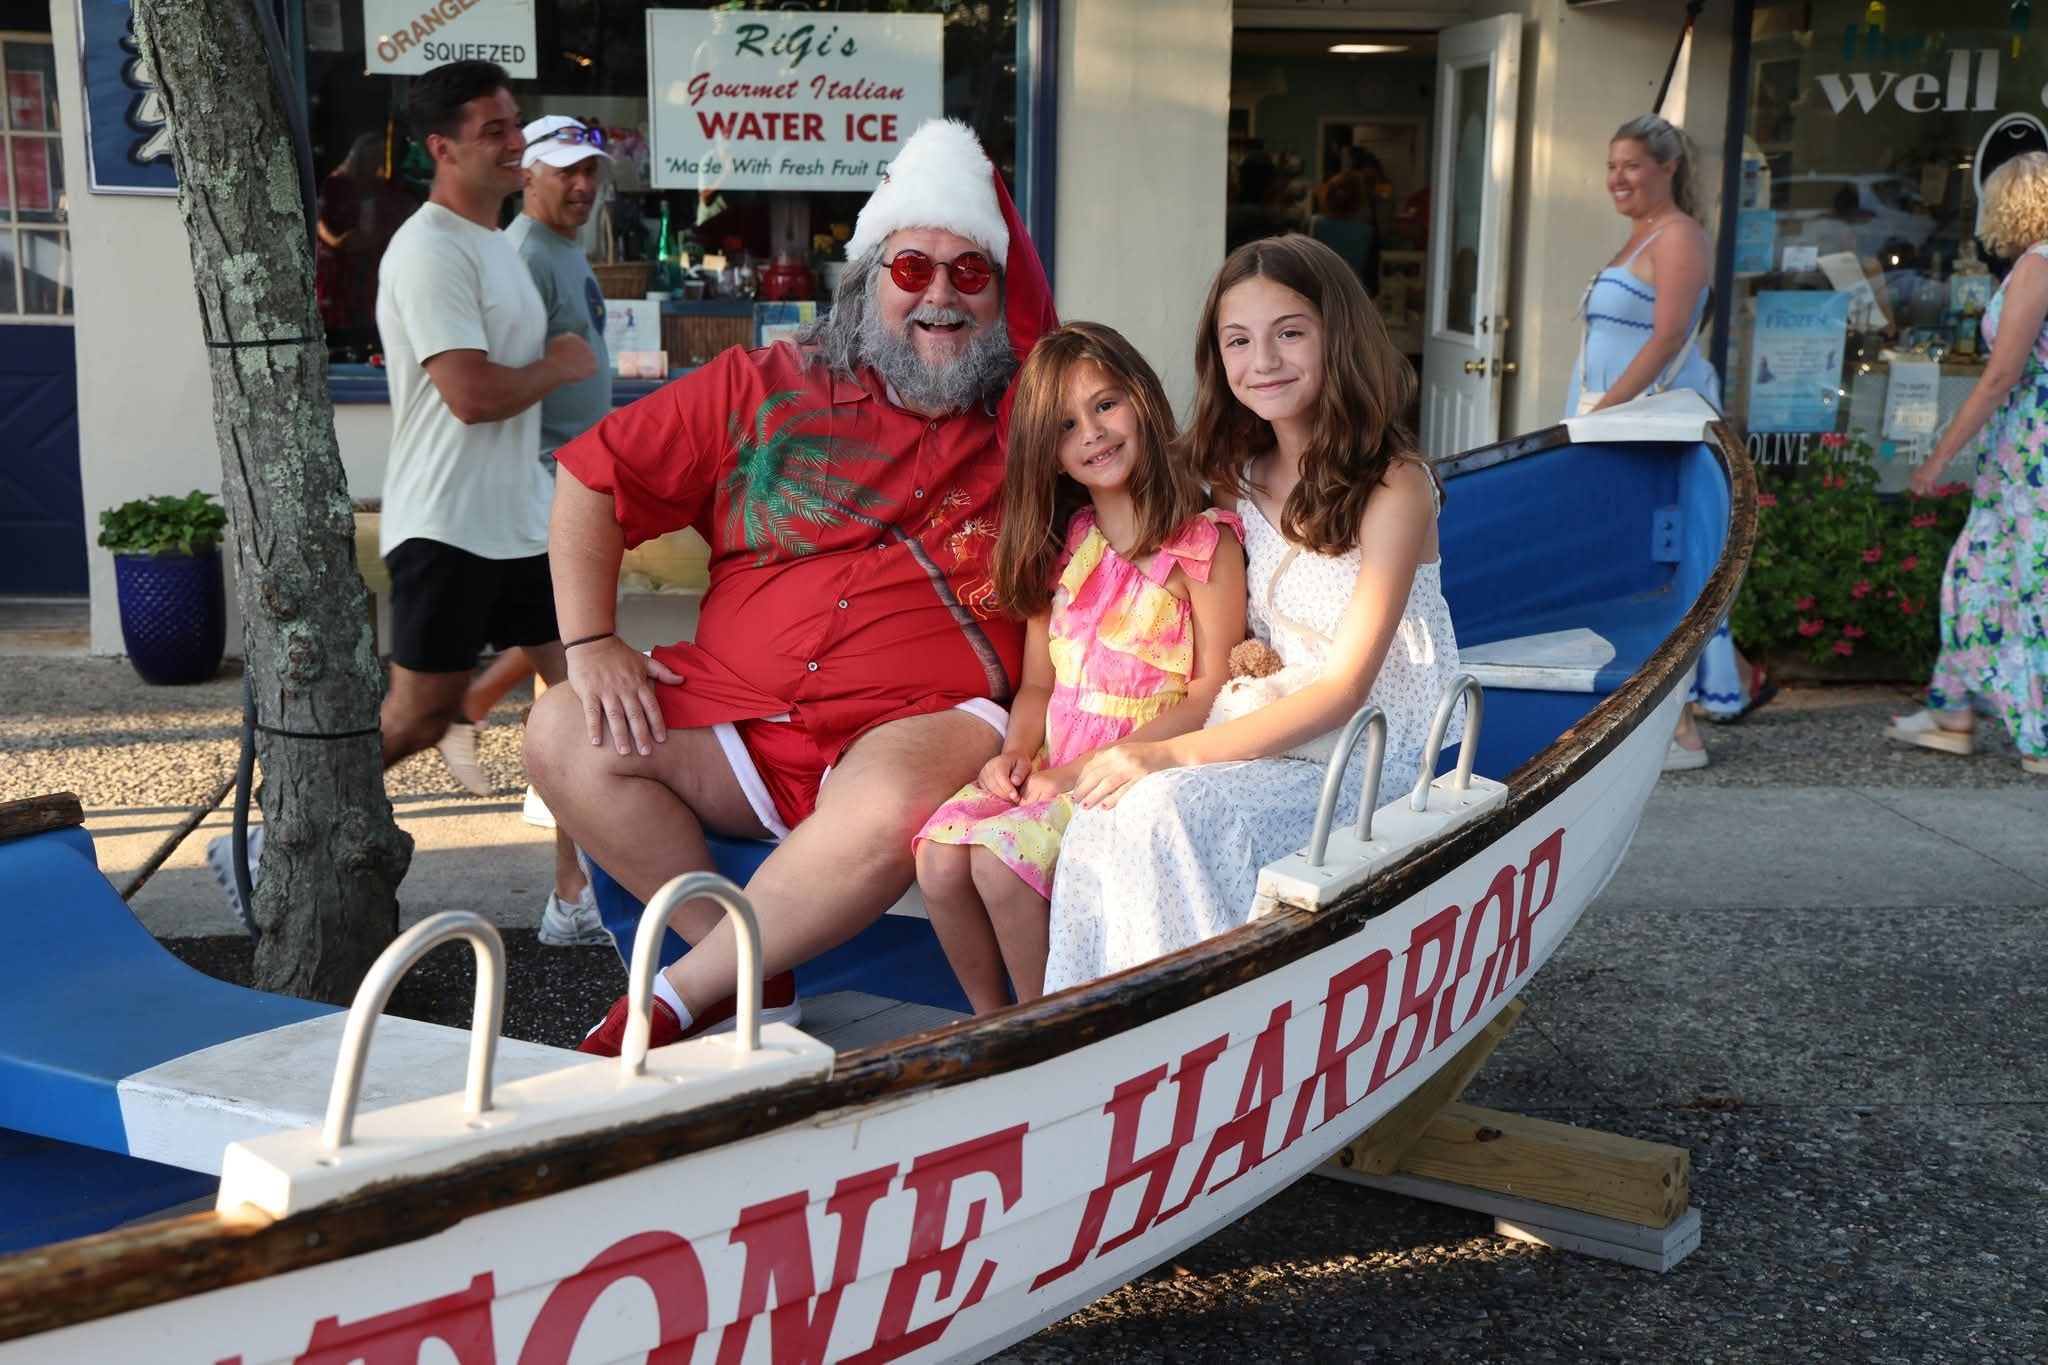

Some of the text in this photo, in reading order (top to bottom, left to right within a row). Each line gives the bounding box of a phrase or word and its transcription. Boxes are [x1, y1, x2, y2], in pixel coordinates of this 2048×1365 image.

[423, 41, 526, 64] SQUEEZED
[735, 23, 858, 69] RiGi's
[687, 72, 904, 106] Gourmet Italian
[1813, 49, 2000, 115] well
[697, 112, 898, 142] WATER ICE
[732, 158, 772, 175] With
[779, 158, 824, 176] Fresh
[831, 159, 869, 177] Fruit
[1745, 431, 1810, 466] OLIVE
[212, 827, 1567, 1365] ONE HARBOR
